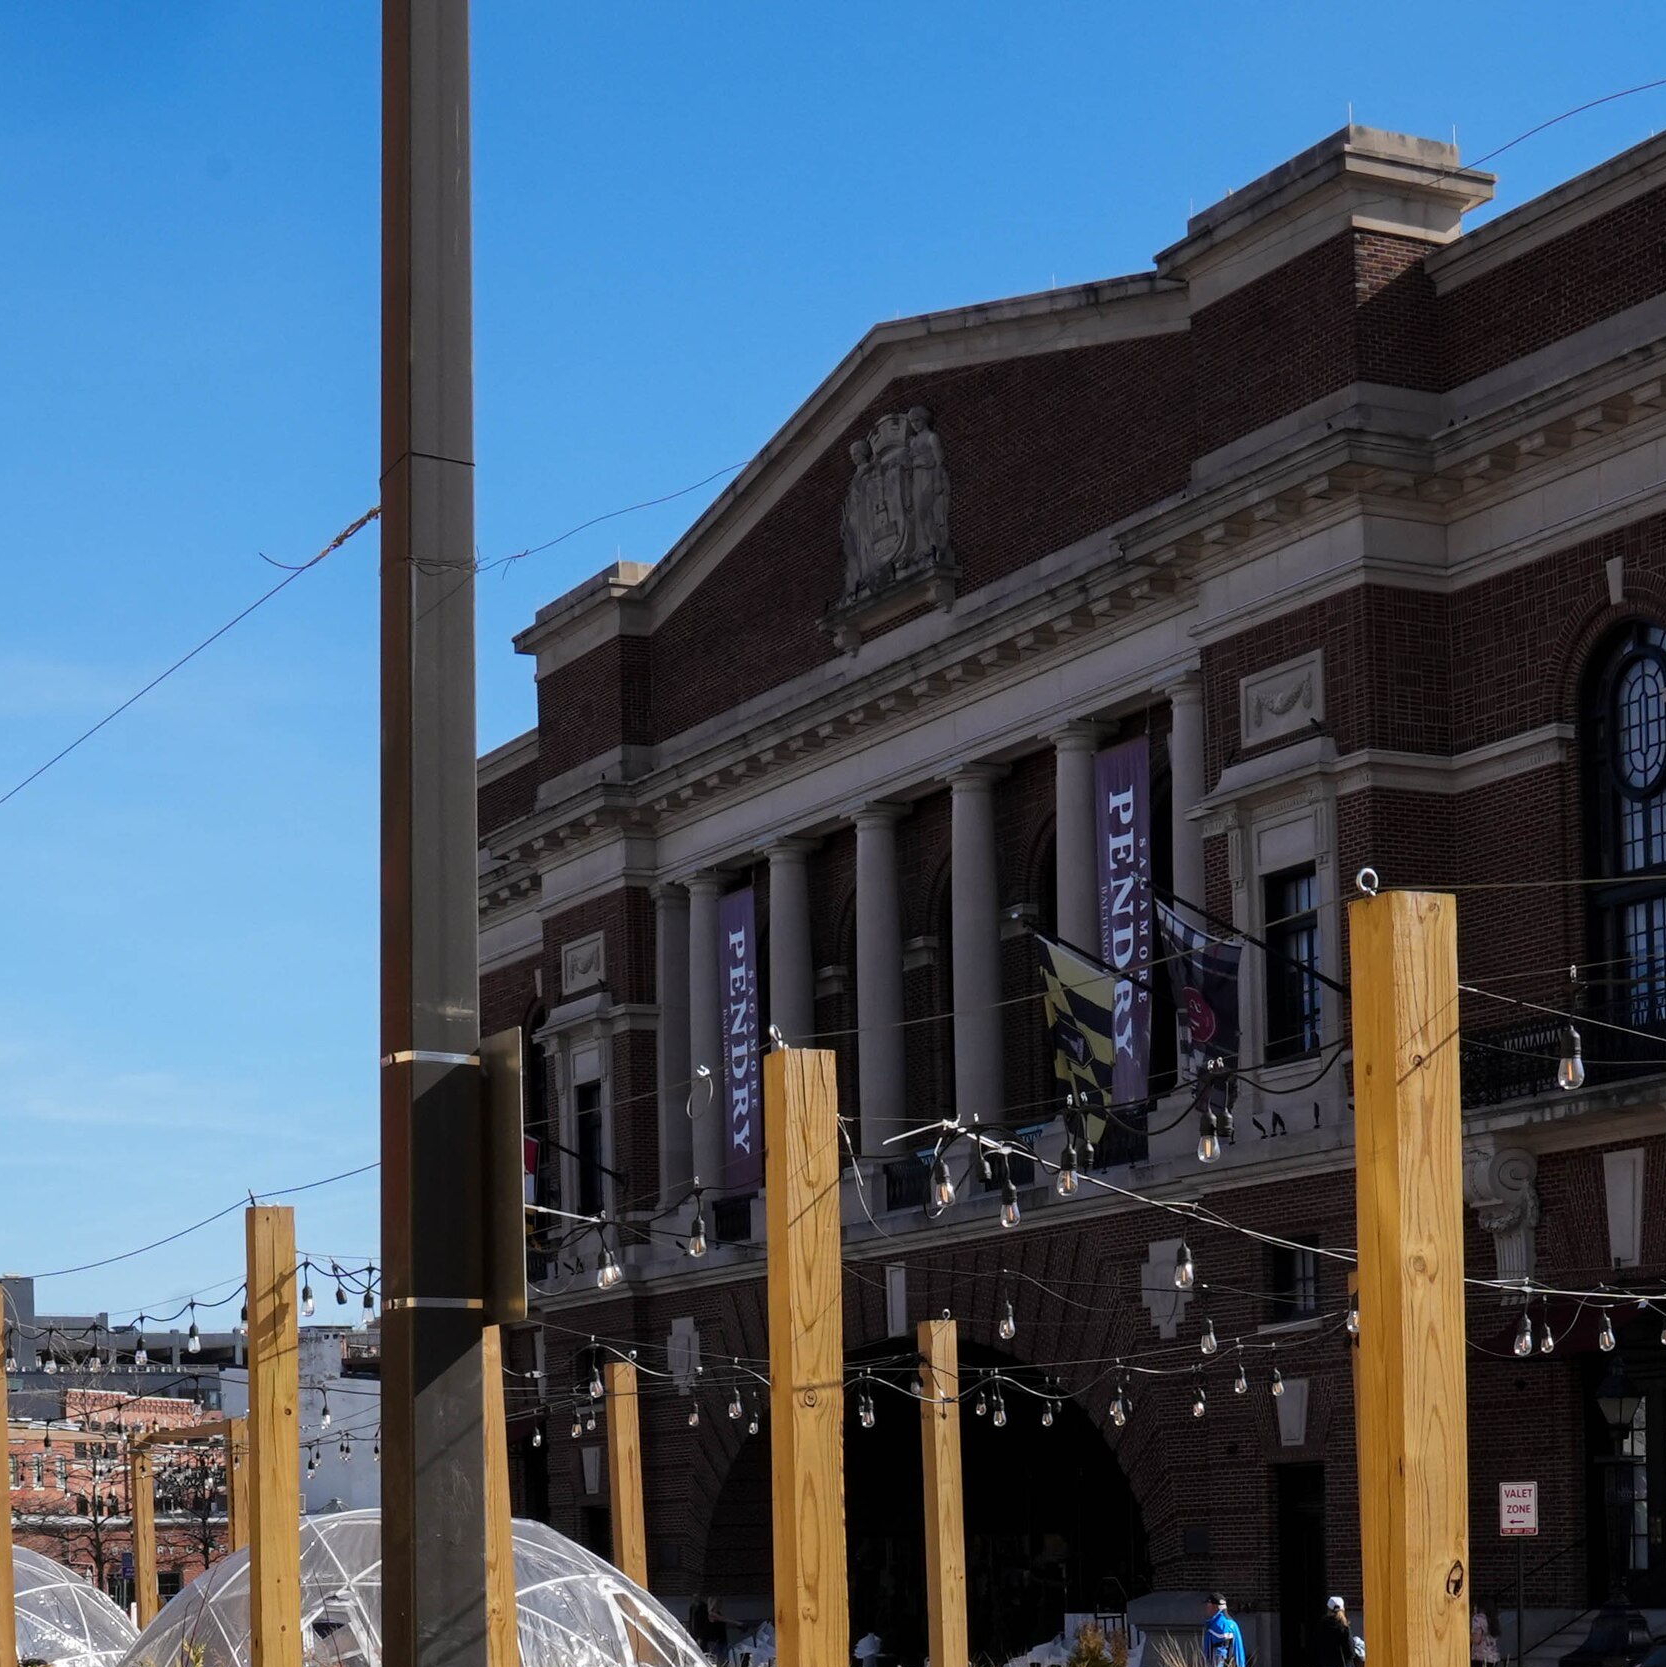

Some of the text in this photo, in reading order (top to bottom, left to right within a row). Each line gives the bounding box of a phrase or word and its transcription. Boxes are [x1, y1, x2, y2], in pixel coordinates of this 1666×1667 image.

[1108, 785, 1134, 1058] PENDRY
[729, 926, 750, 1154] PENDRY
[1504, 1489, 1533, 1498] VALET
[1506, 1505, 1531, 1513] ZONE
